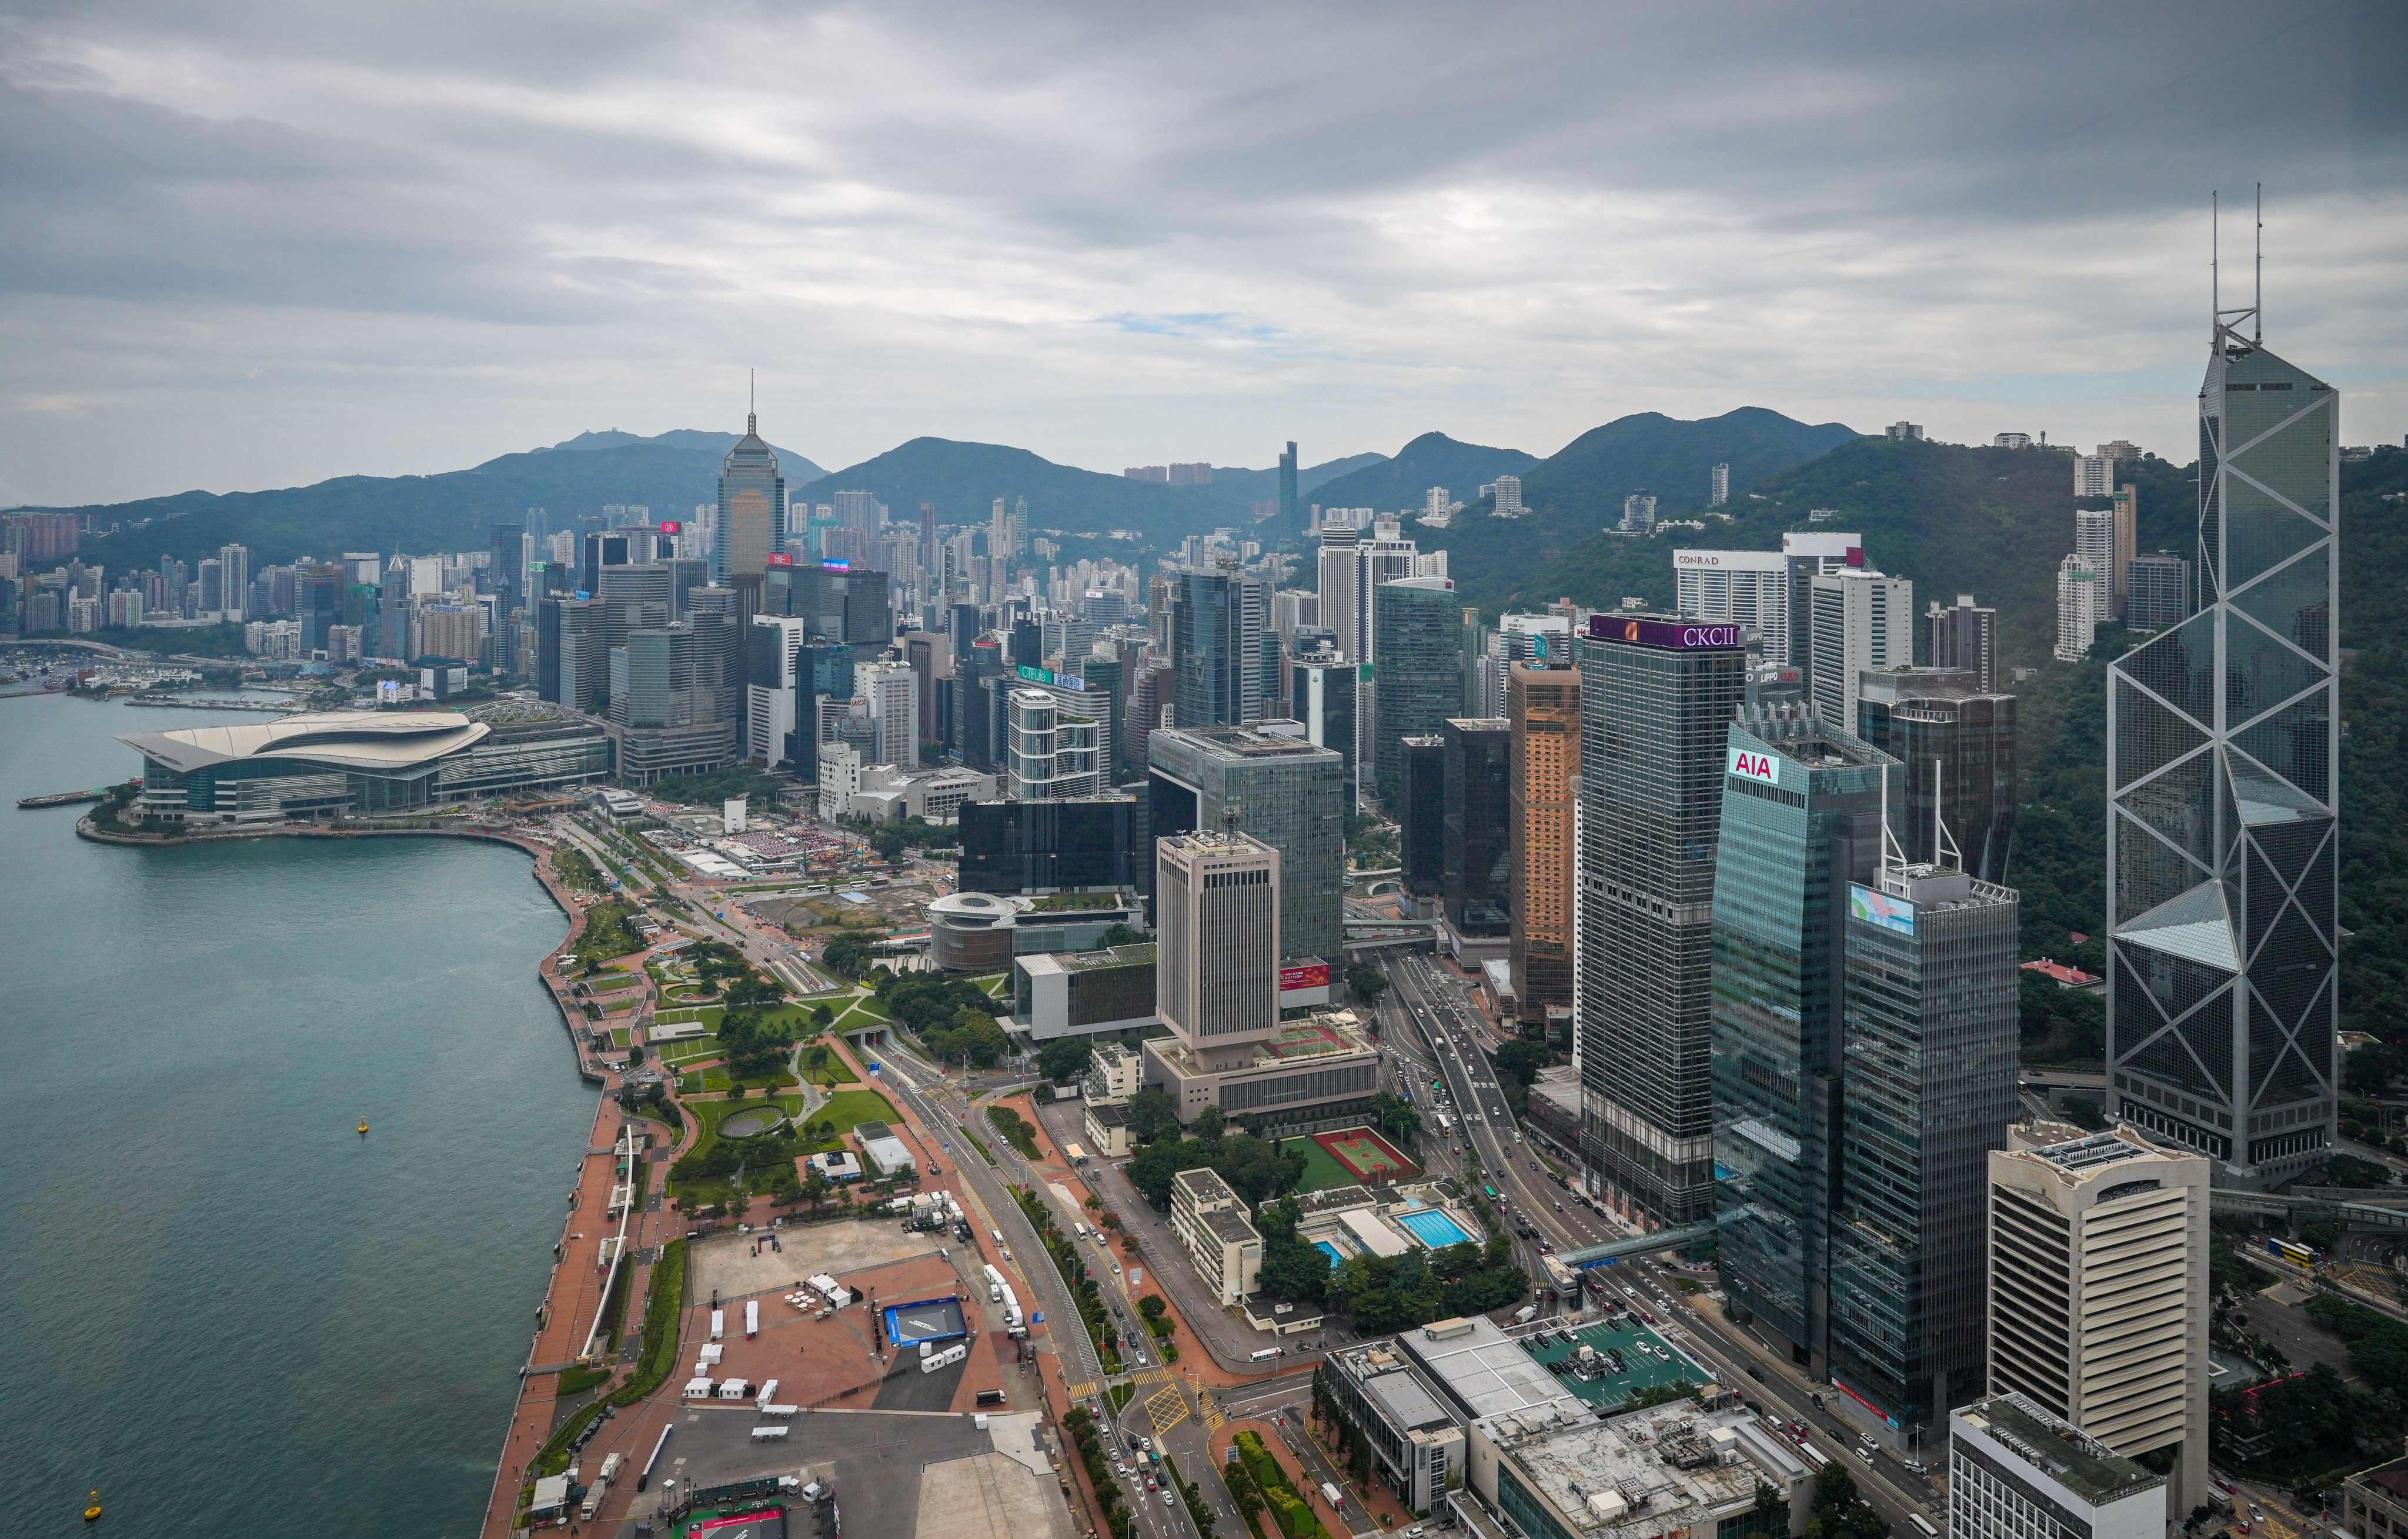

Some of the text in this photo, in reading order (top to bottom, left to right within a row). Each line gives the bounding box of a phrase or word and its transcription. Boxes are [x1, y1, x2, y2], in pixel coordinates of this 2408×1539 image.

[1678, 556, 1719, 565] CONRAD
[431, 603, 462, 613] Panasonic
[1684, 627, 1734, 646] CKCII
[1746, 631, 1763, 642] LIPPO
[1760, 672, 1778, 683] LIPPO
[851, 698, 866, 707] YMCA
[1735, 753, 1772, 779] AIA
